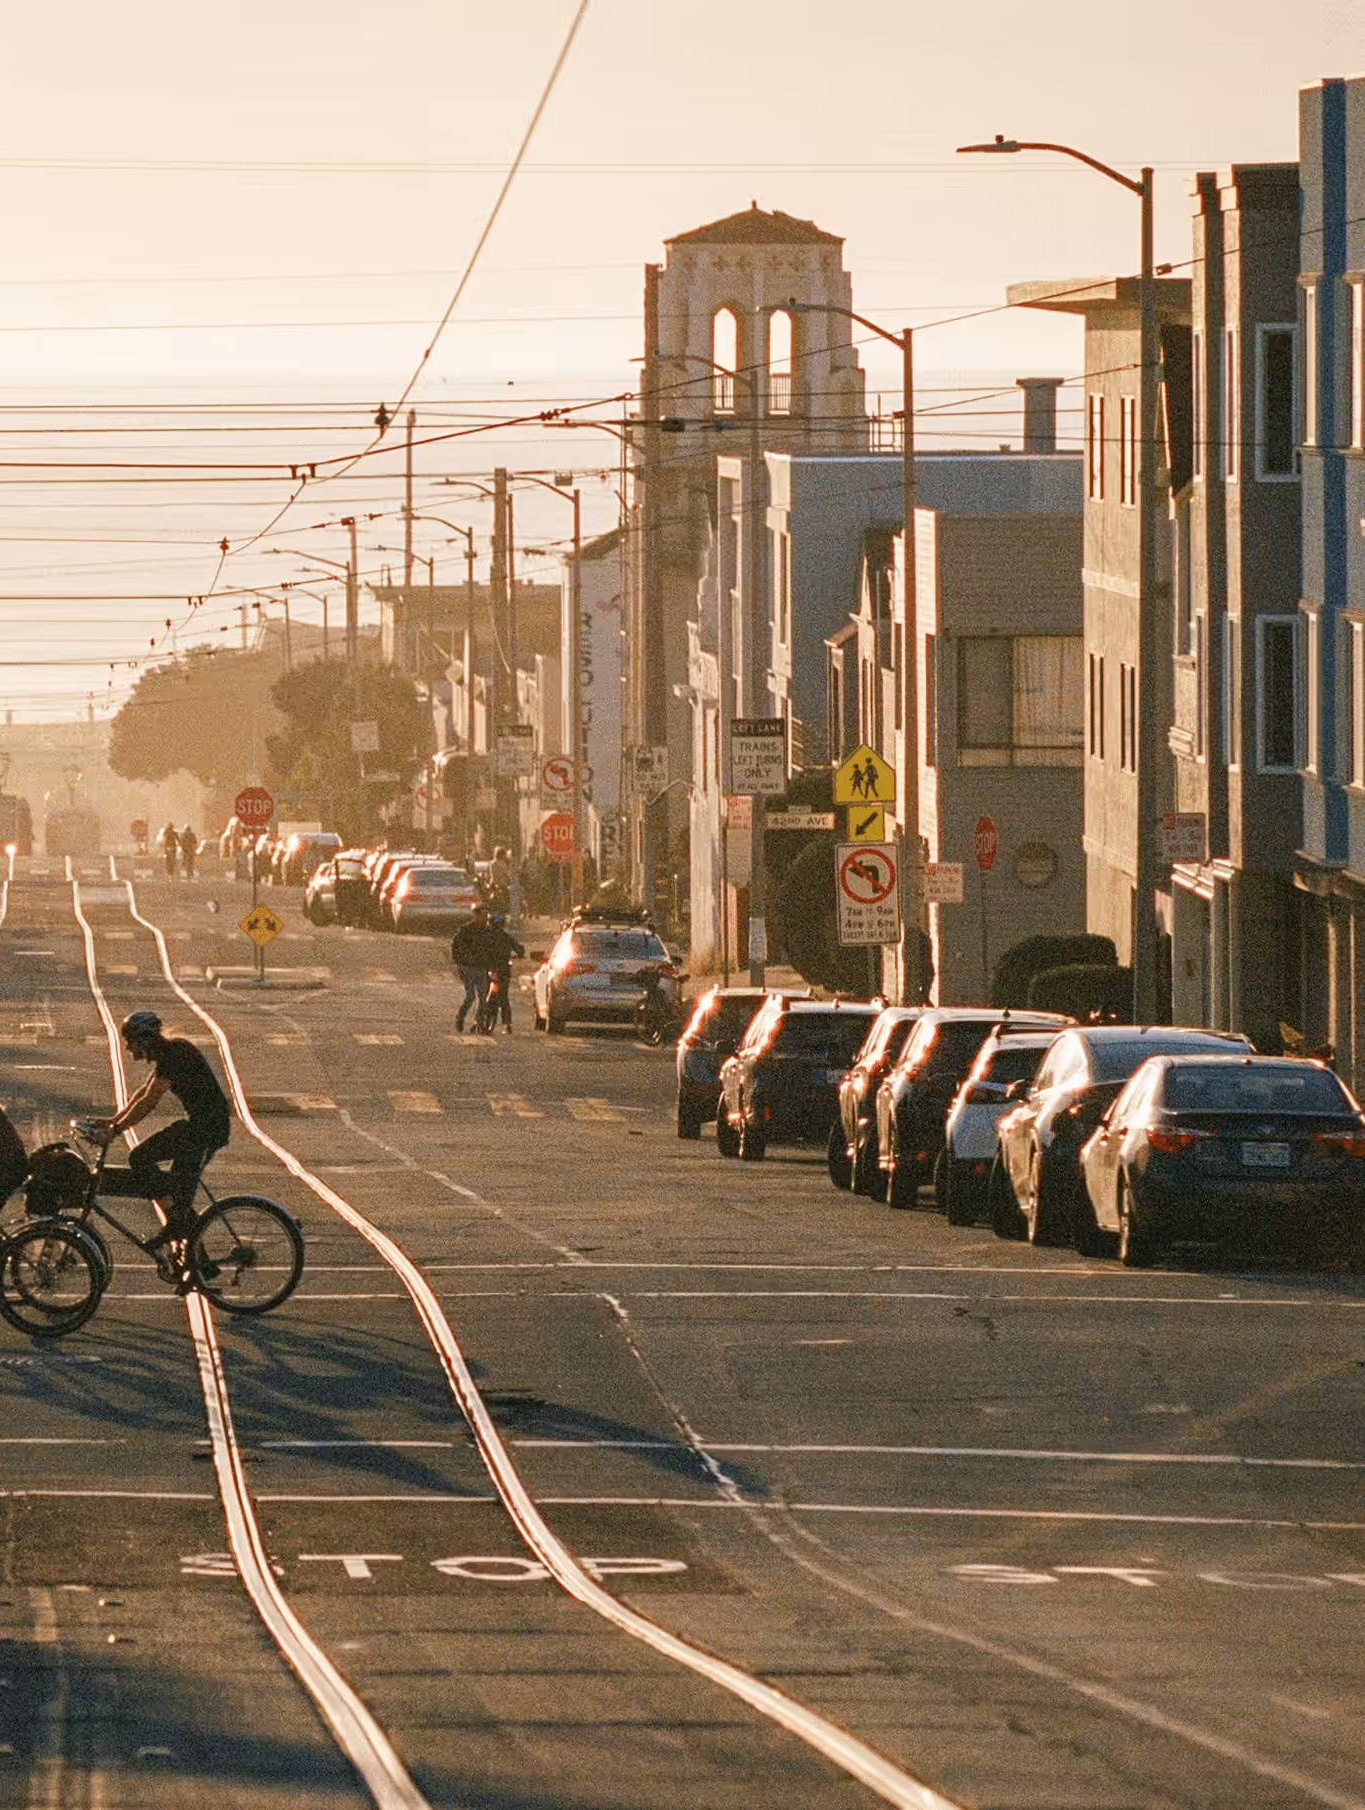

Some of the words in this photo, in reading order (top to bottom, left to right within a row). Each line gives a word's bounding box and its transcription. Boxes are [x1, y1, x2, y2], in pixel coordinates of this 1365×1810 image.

[739, 742, 777, 752] TRAINS
[734, 755, 754, 765] LEFT
[756, 755, 782, 765] TURNS
[744, 768, 772, 778] ONLY
[237, 799, 272, 815] STOP
[806, 816, 829, 826] AVE
[543, 825, 573, 841] STO
[976, 831, 997, 854] STOP
[846, 906, 863, 916] 7AM
[877, 905, 894, 915] 9AM
[844, 919, 864, 929] 4PM
[877, 919, 895, 929] 6PM
[179, 1553, 688, 1582] STOP
